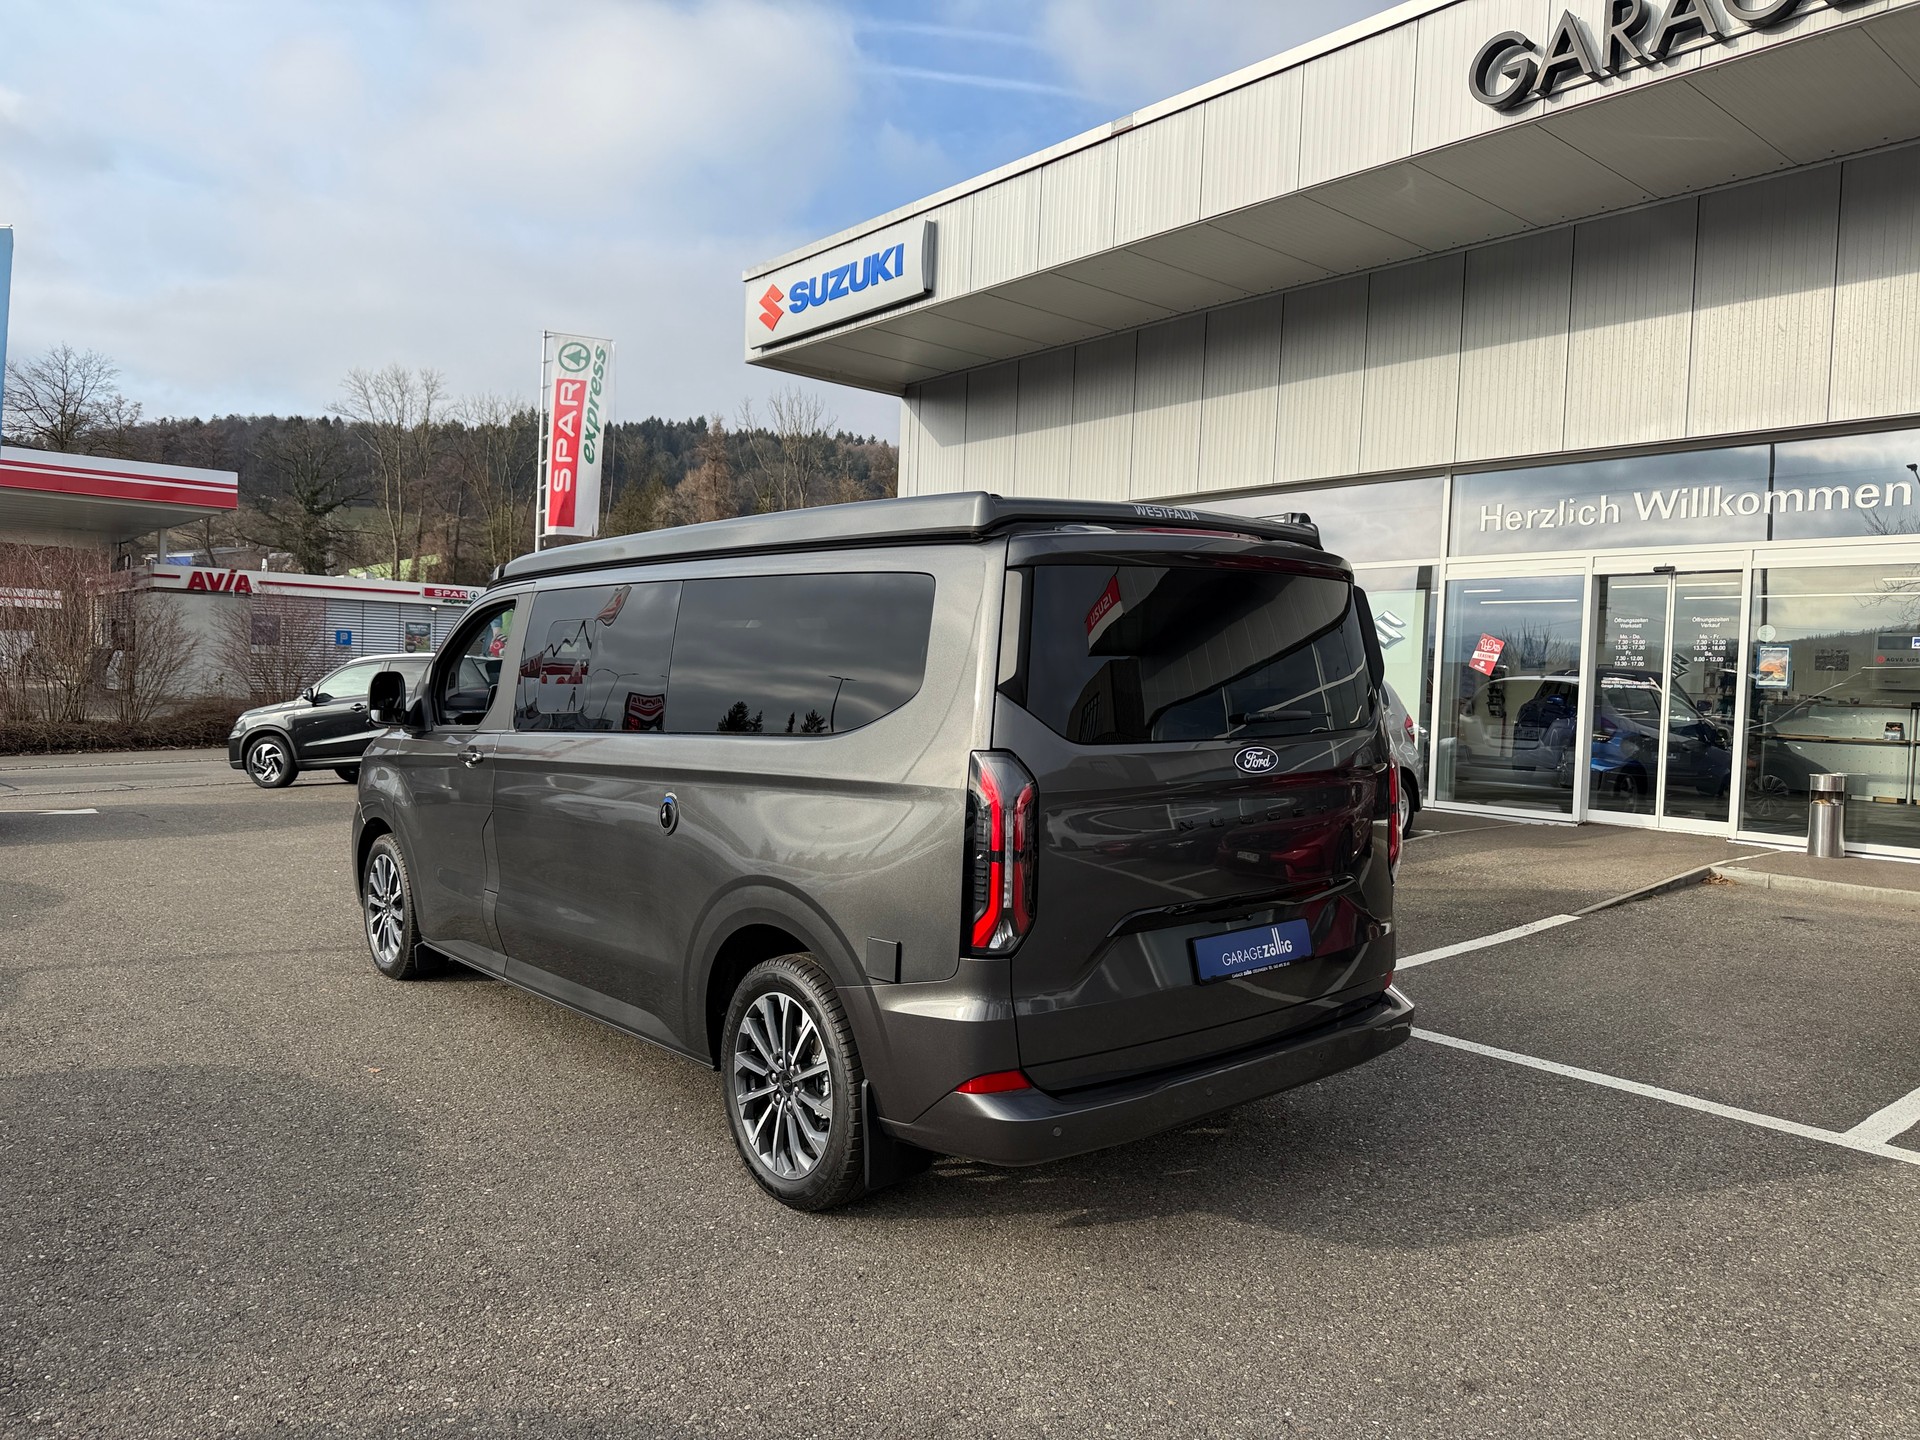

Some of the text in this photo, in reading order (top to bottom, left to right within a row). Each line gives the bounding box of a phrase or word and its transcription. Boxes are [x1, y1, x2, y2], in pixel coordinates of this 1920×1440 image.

[1468, 0, 1803, 110] GARA
[788, 243, 905, 314] SUZUKI
[583, 345, 607, 465] express
[553, 381, 582, 493] SPAR
[1133, 505, 1200, 521] WESTFALIA
[1479, 478, 1913, 532] Herzlich Willkommen
[433, 589, 468, 598] SPAR
[339, 632, 349, 644] P
[1243, 750, 1271, 769] Ford
